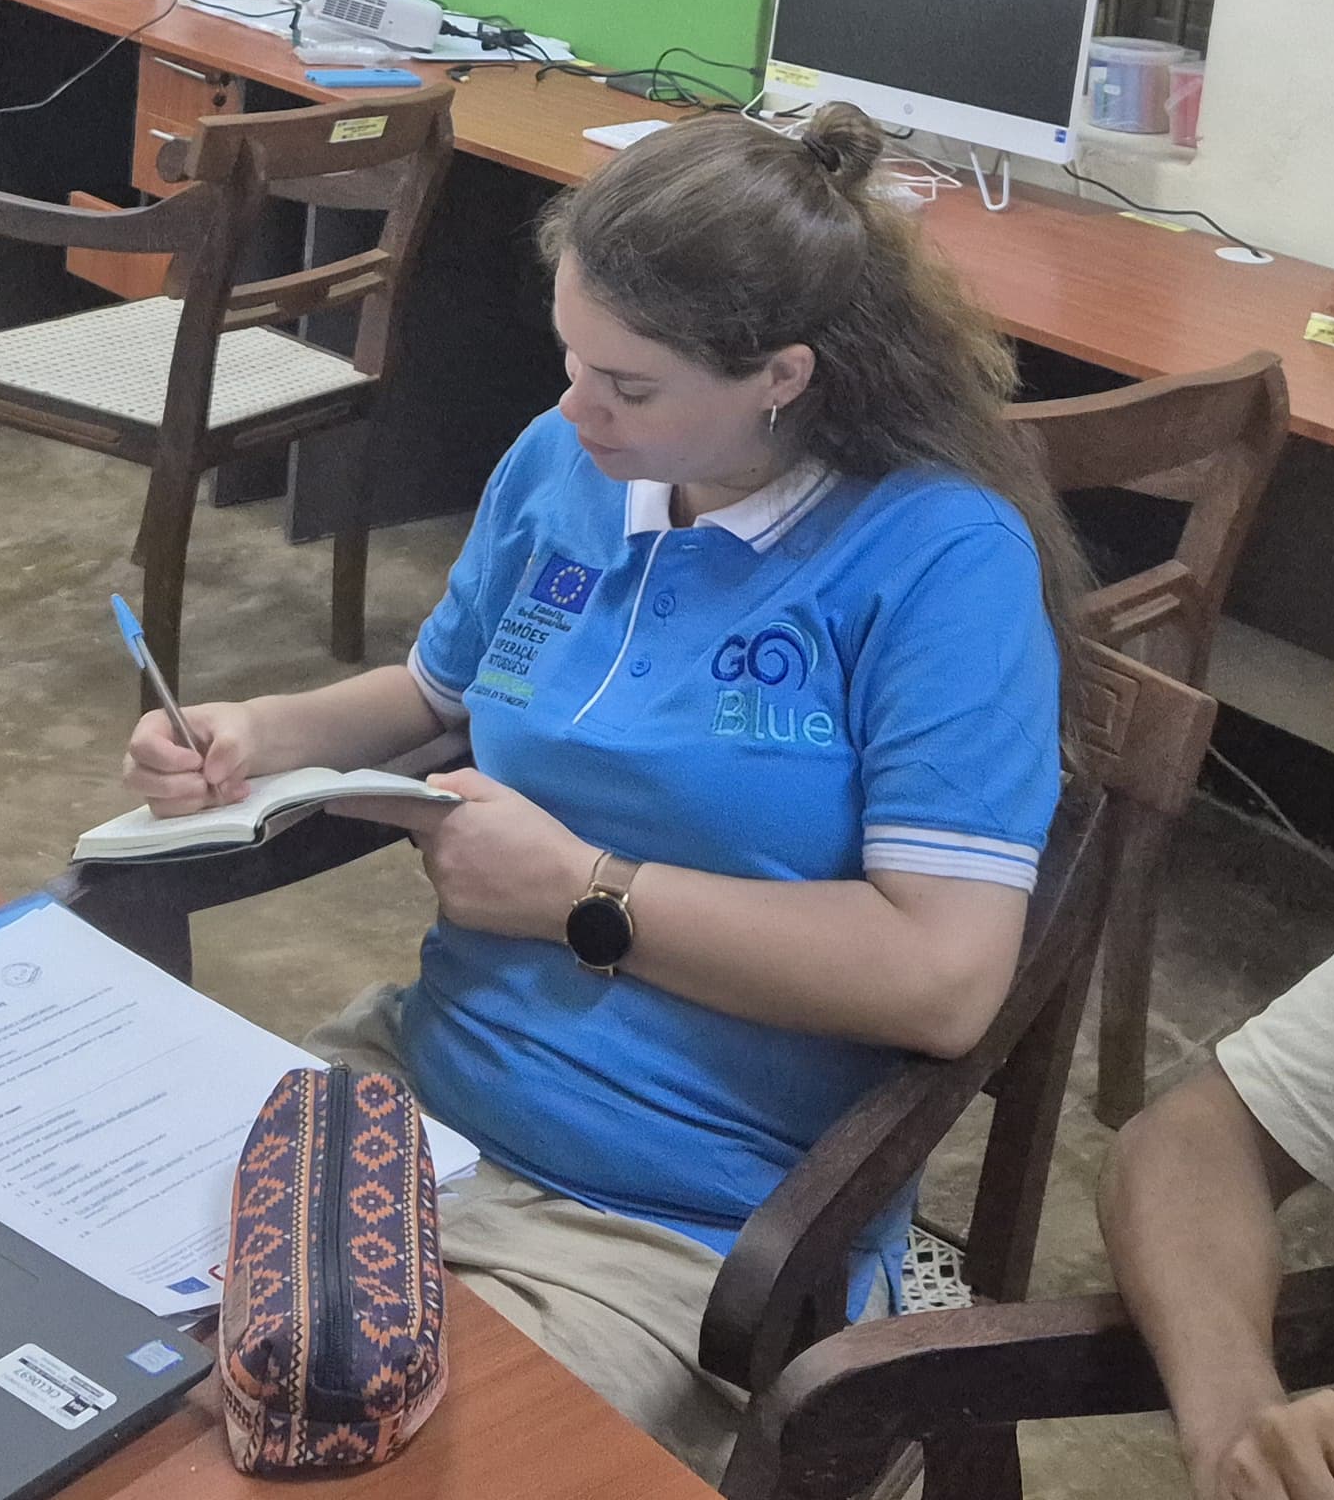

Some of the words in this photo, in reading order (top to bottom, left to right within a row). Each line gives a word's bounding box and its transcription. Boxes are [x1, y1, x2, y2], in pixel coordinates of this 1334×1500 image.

[499, 619, 550, 644] AMÕES
[711, 626, 810, 691] GO
[712, 689, 835, 746] Blue
